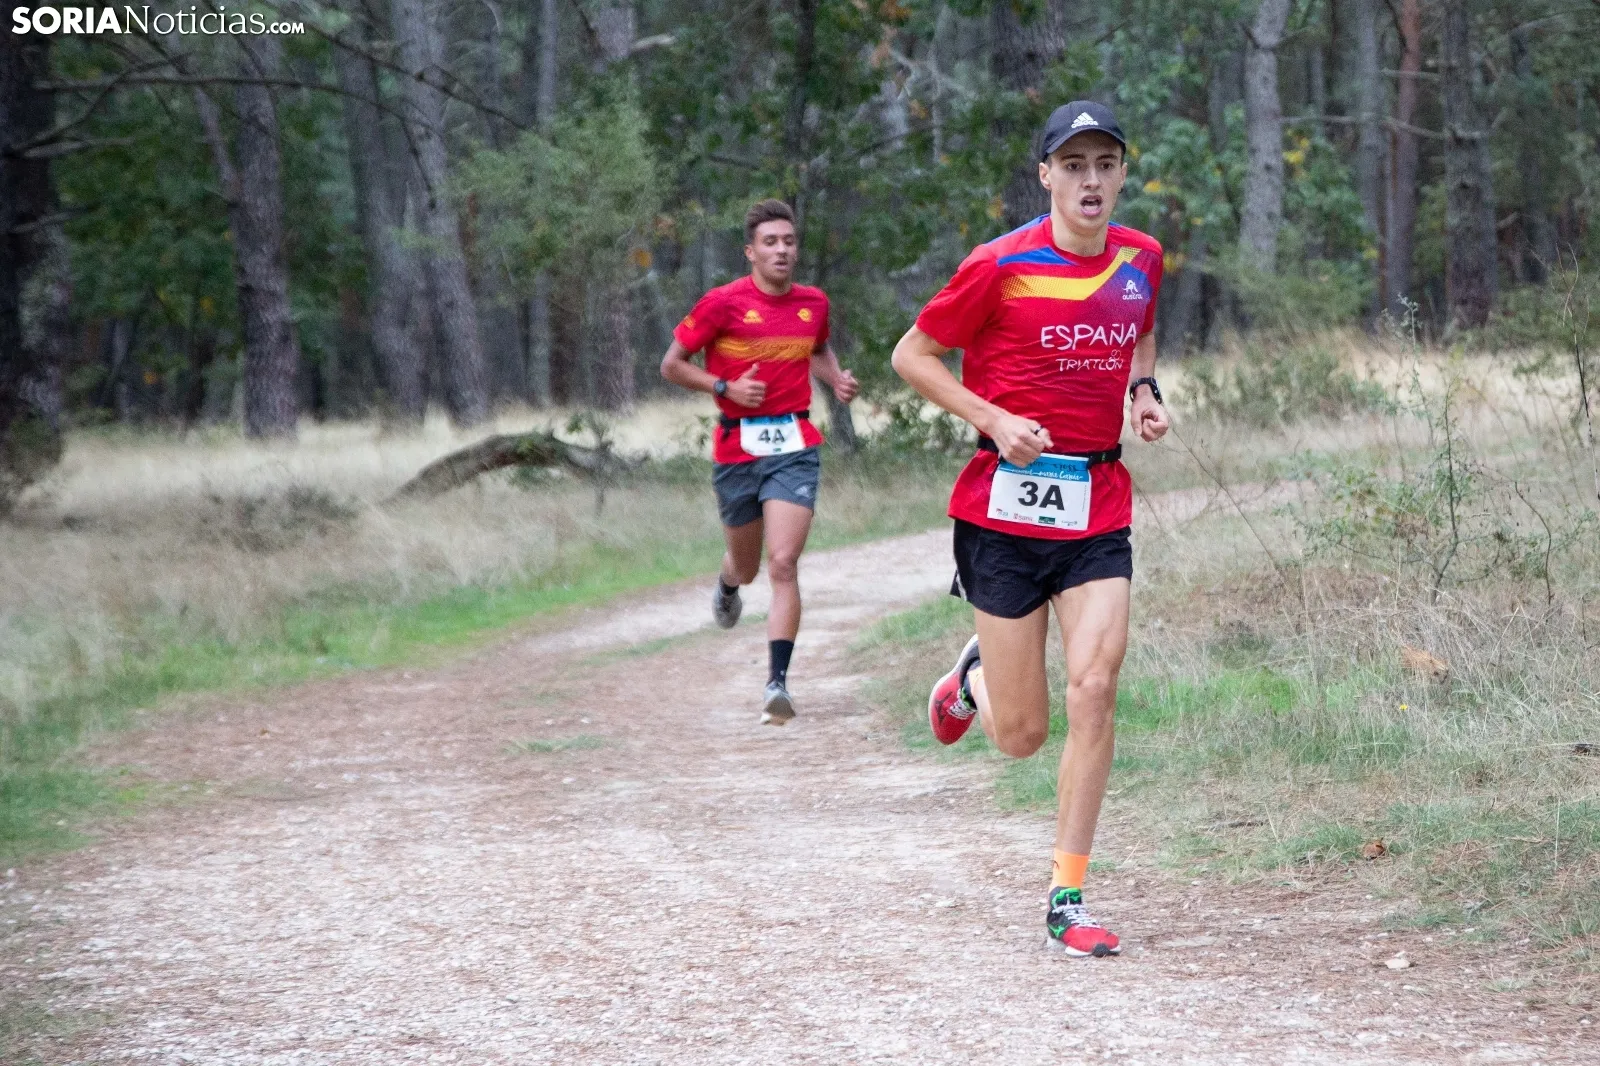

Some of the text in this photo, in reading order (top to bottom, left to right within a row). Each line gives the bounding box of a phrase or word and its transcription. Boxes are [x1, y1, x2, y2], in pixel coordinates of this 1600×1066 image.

[1040, 322, 1137, 350] ESPAÑA
[758, 428, 785, 444] 4A
[1017, 481, 1065, 510] 3A
